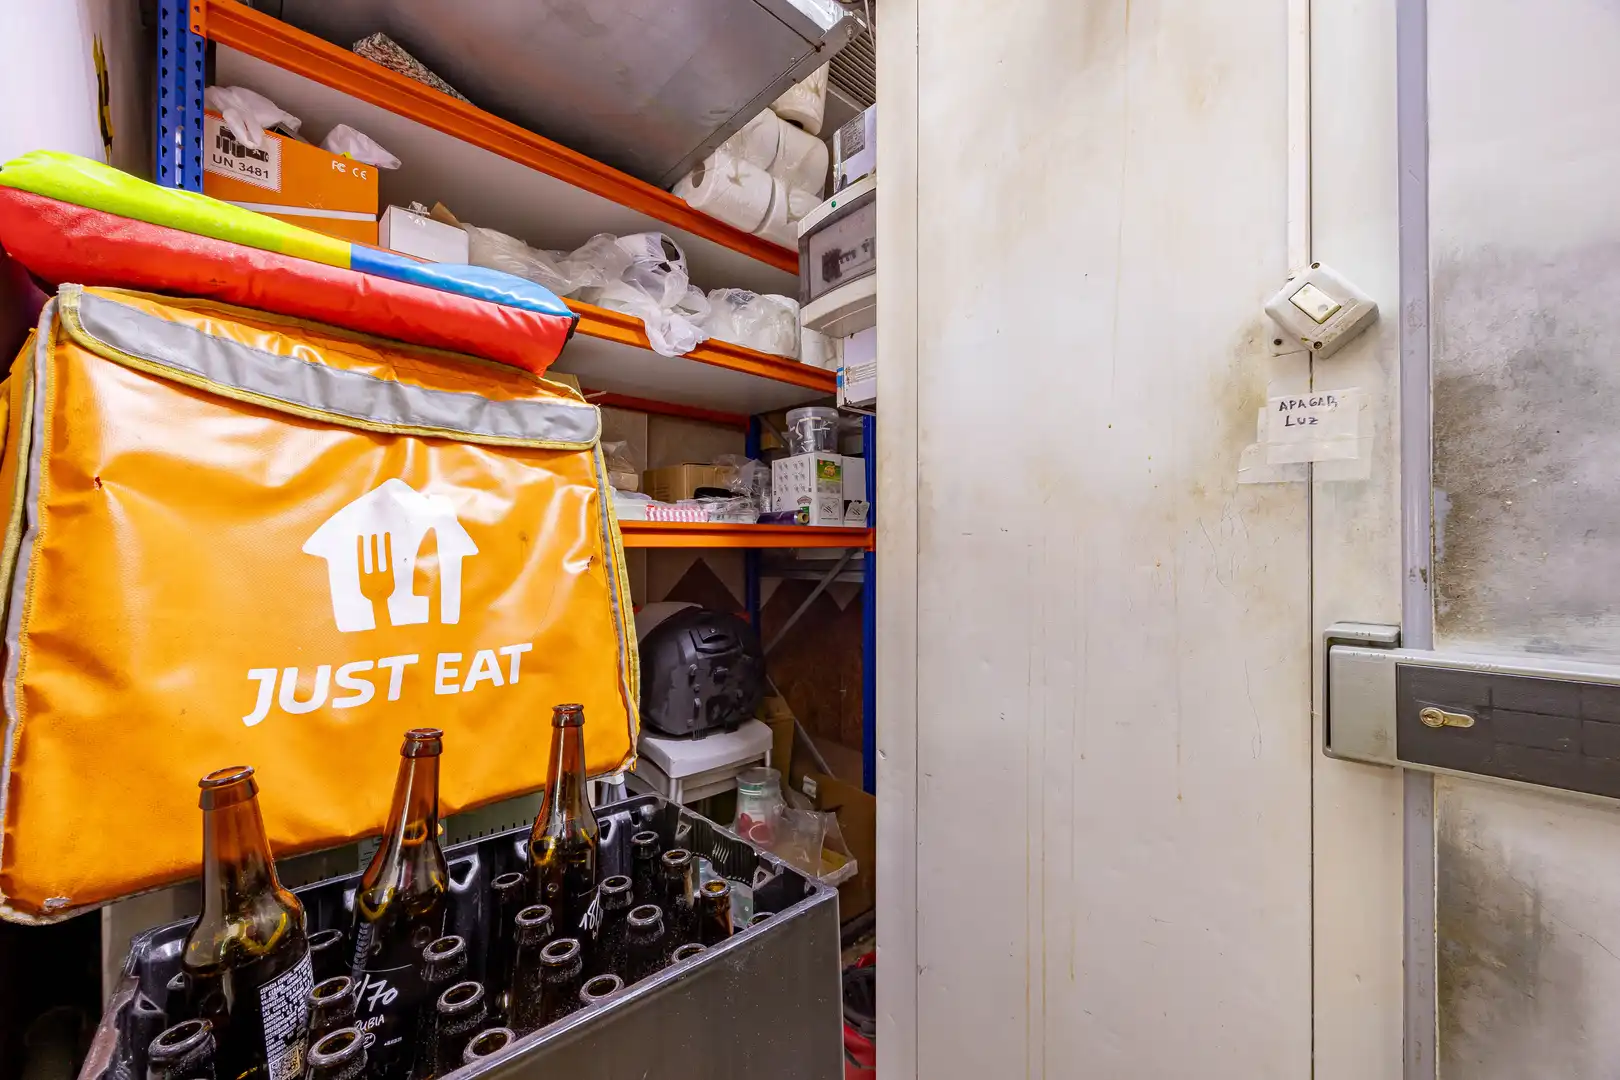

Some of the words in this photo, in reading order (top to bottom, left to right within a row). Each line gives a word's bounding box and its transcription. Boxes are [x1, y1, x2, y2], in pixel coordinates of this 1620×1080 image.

[212, 153, 234, 169] UN
[238, 162, 270, 179] 3481
[352, 167, 367, 180] CE
[1284, 415, 1319, 427] LUZ
[242, 653, 420, 728] JUST
[435, 642, 533, 695] EAT
